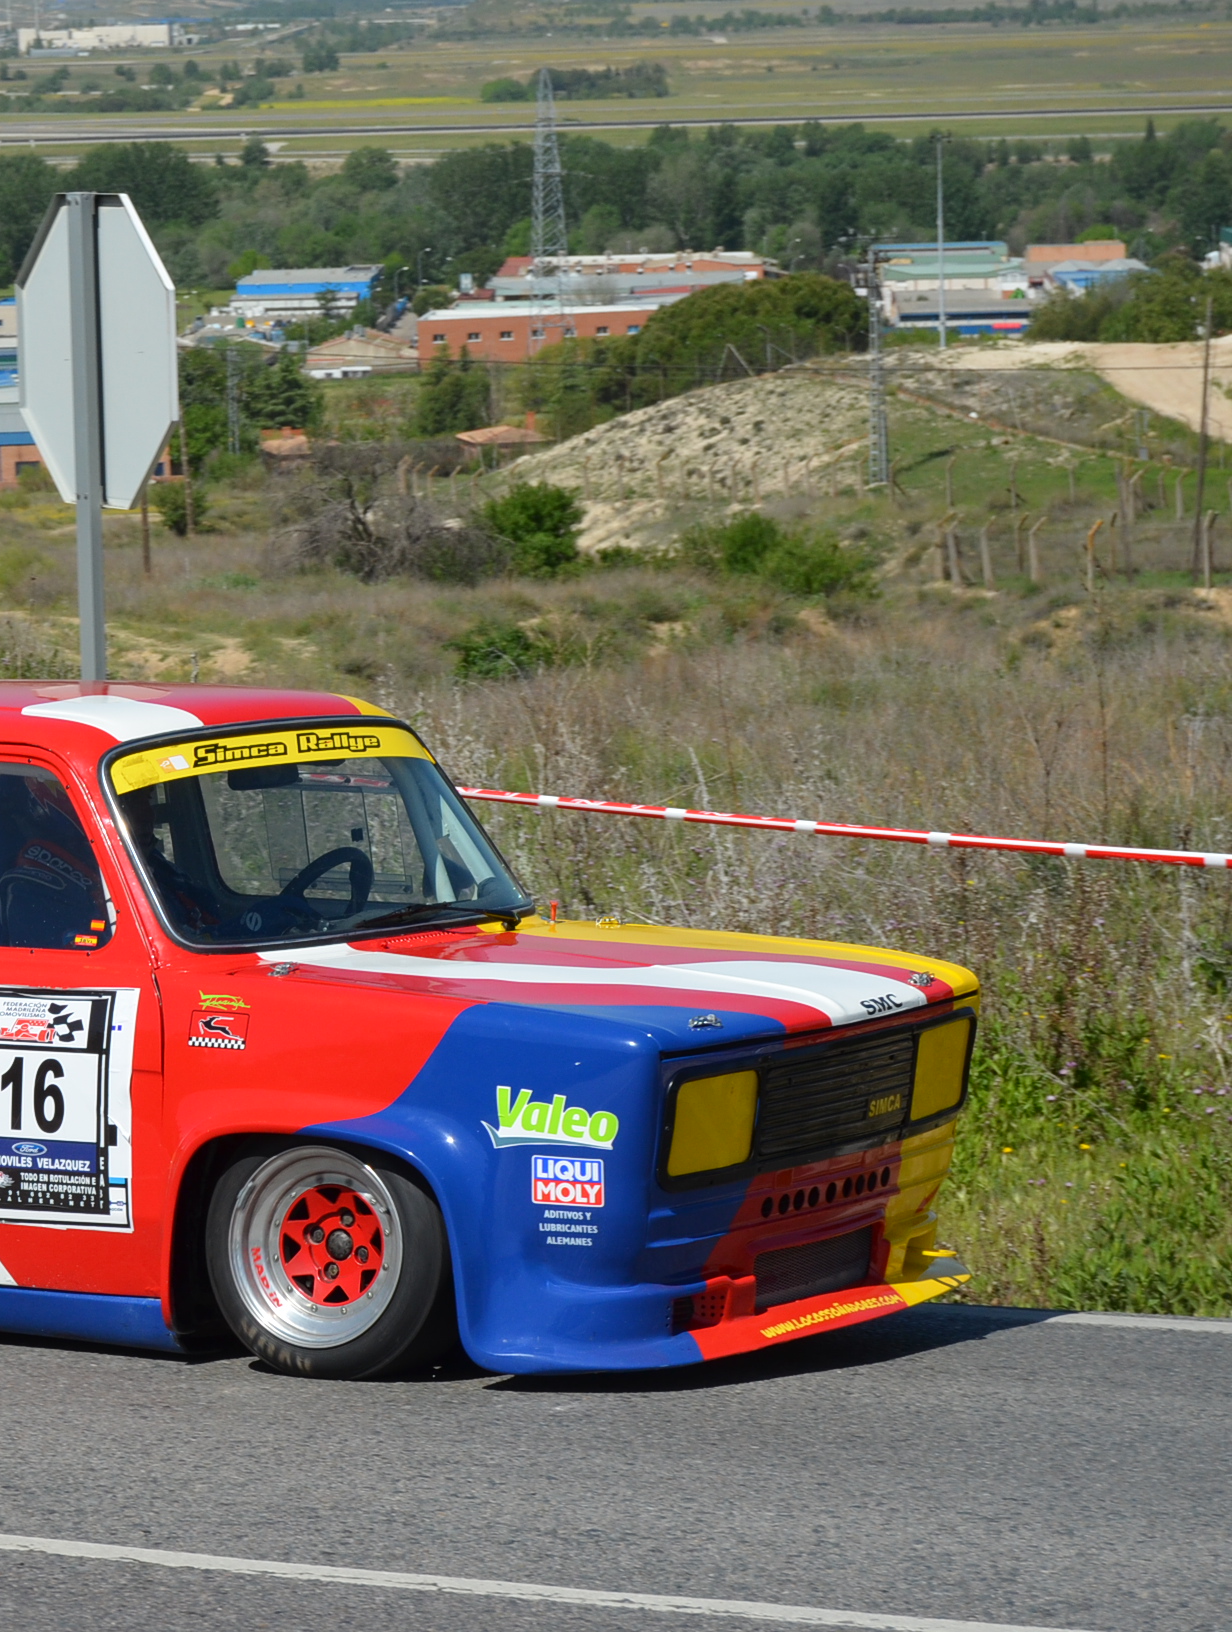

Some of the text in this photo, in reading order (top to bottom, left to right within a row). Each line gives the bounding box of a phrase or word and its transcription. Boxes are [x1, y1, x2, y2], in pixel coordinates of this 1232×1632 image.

[193, 732, 381, 768] Simca Rallye
[860, 993, 903, 1015] SMC
[0, 1056, 65, 1134] 16
[496, 1085, 619, 1143] Valeo
[868, 1093, 901, 1118] SIMCA
[19, 1145, 40, 1153] Ford
[36, 1157, 91, 1172] VELAZQUEZ
[536, 1158, 599, 1182] LIQUI
[20, 1172, 97, 1185] TODO EN ROTULACIÓN E
[20, 1182, 97, 1195] IMAGEN CORPORATIVA
[536, 1181, 601, 1203] MOLY
[544, 1209, 592, 1221] ADITIVOS Y
[539, 1222, 599, 1234] LUBRICANTES
[546, 1236, 593, 1246] ALEMANES
